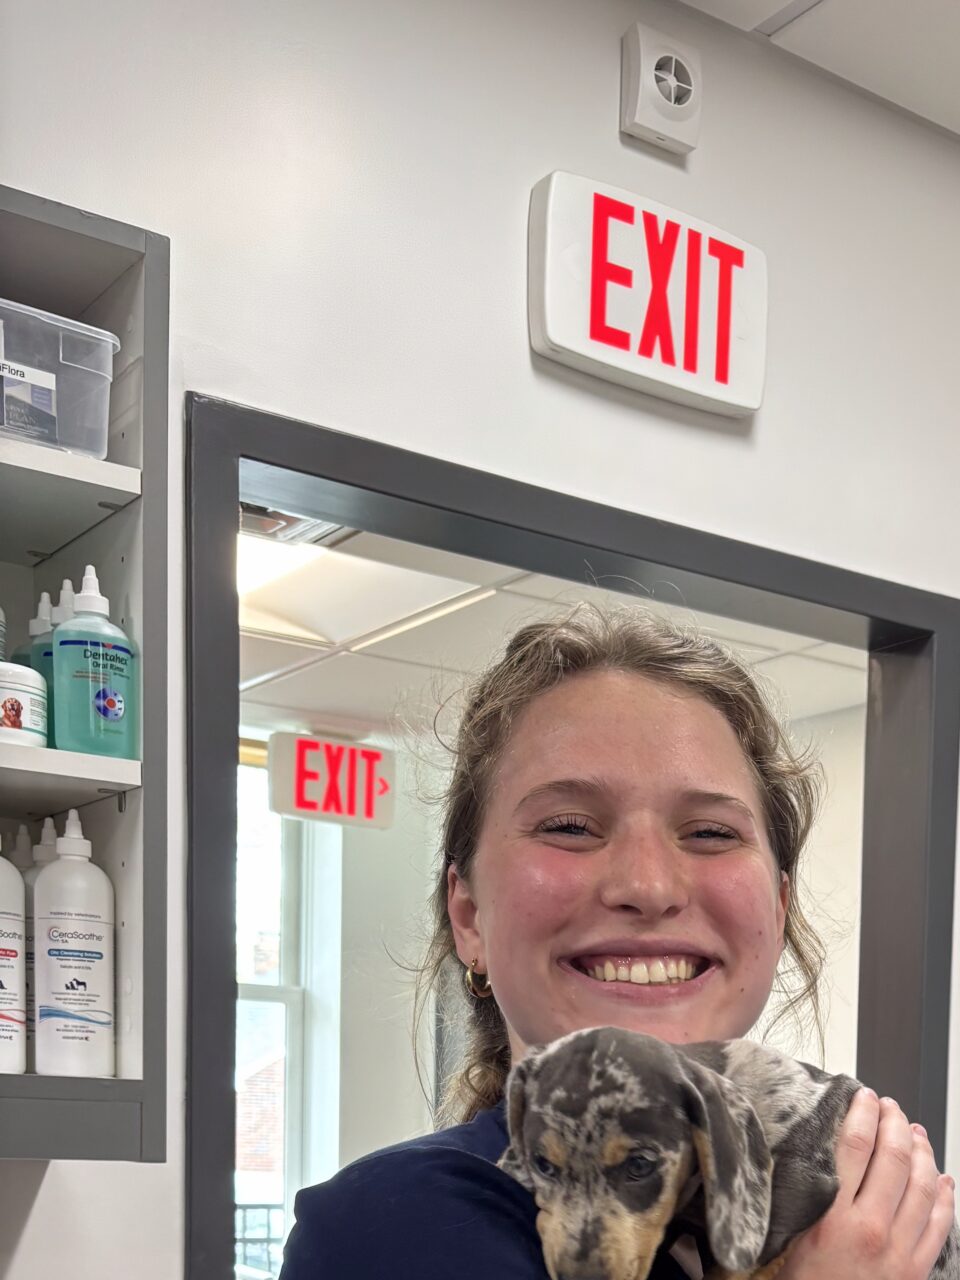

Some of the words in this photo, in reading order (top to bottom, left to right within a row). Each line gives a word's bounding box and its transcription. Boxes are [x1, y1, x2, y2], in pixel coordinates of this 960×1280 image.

[589, 191, 744, 386] EXIT
[0, 363, 25, 378] iFlora
[84, 649, 128, 666] Dentahex
[295, 738, 382, 819] EXIT
[50, 929, 103, 941] CeraSoothe
